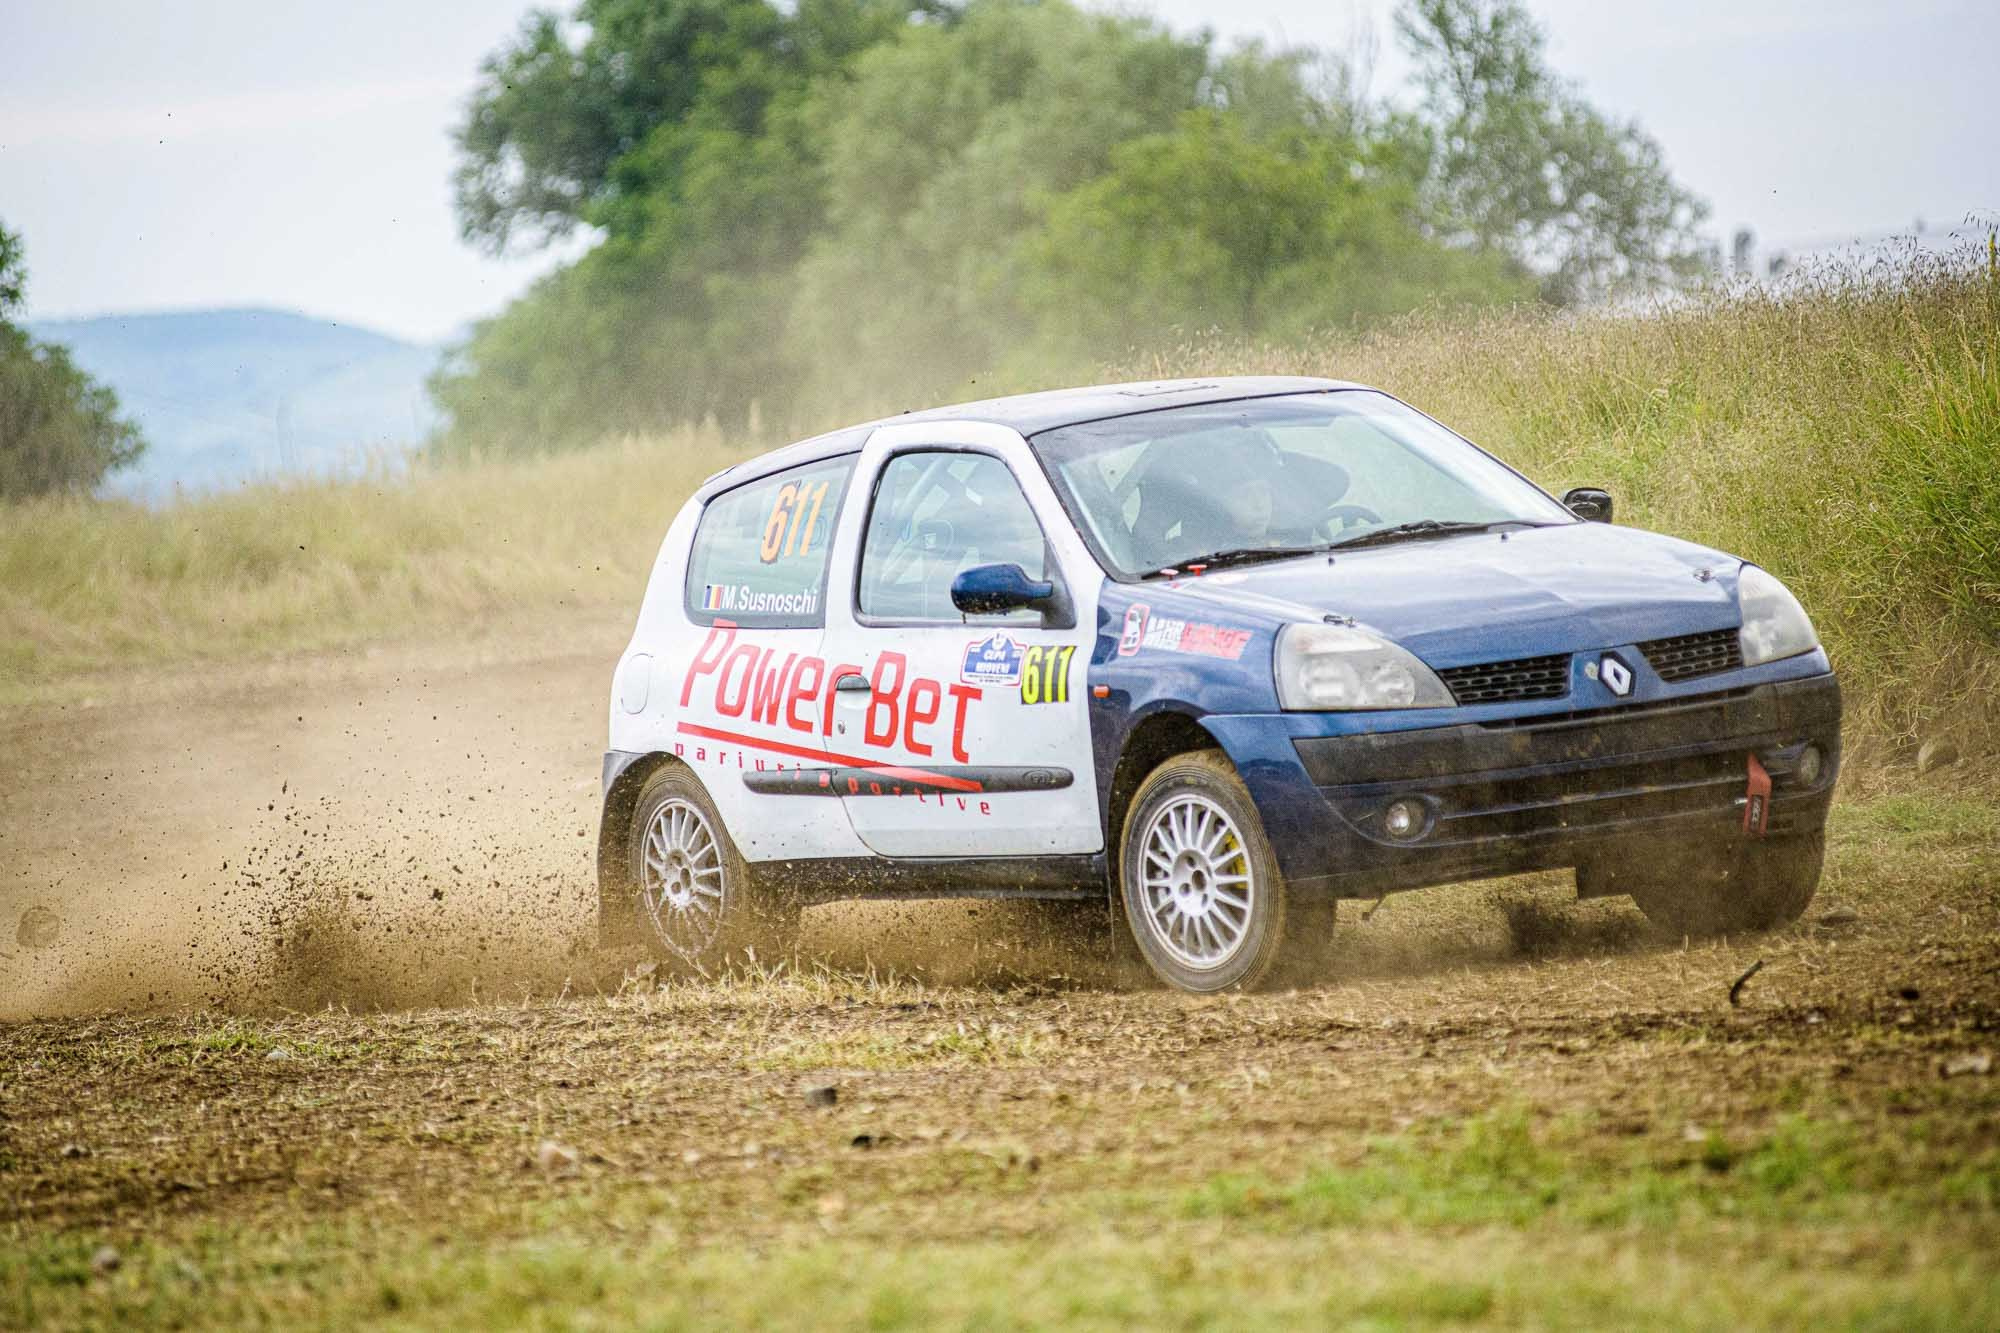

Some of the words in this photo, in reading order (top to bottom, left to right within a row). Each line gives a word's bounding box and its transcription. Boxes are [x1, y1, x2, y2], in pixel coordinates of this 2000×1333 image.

[760, 480, 829, 562] 611
[722, 584, 817, 615] M.Susnoschi
[1022, 646, 1076, 704] 611
